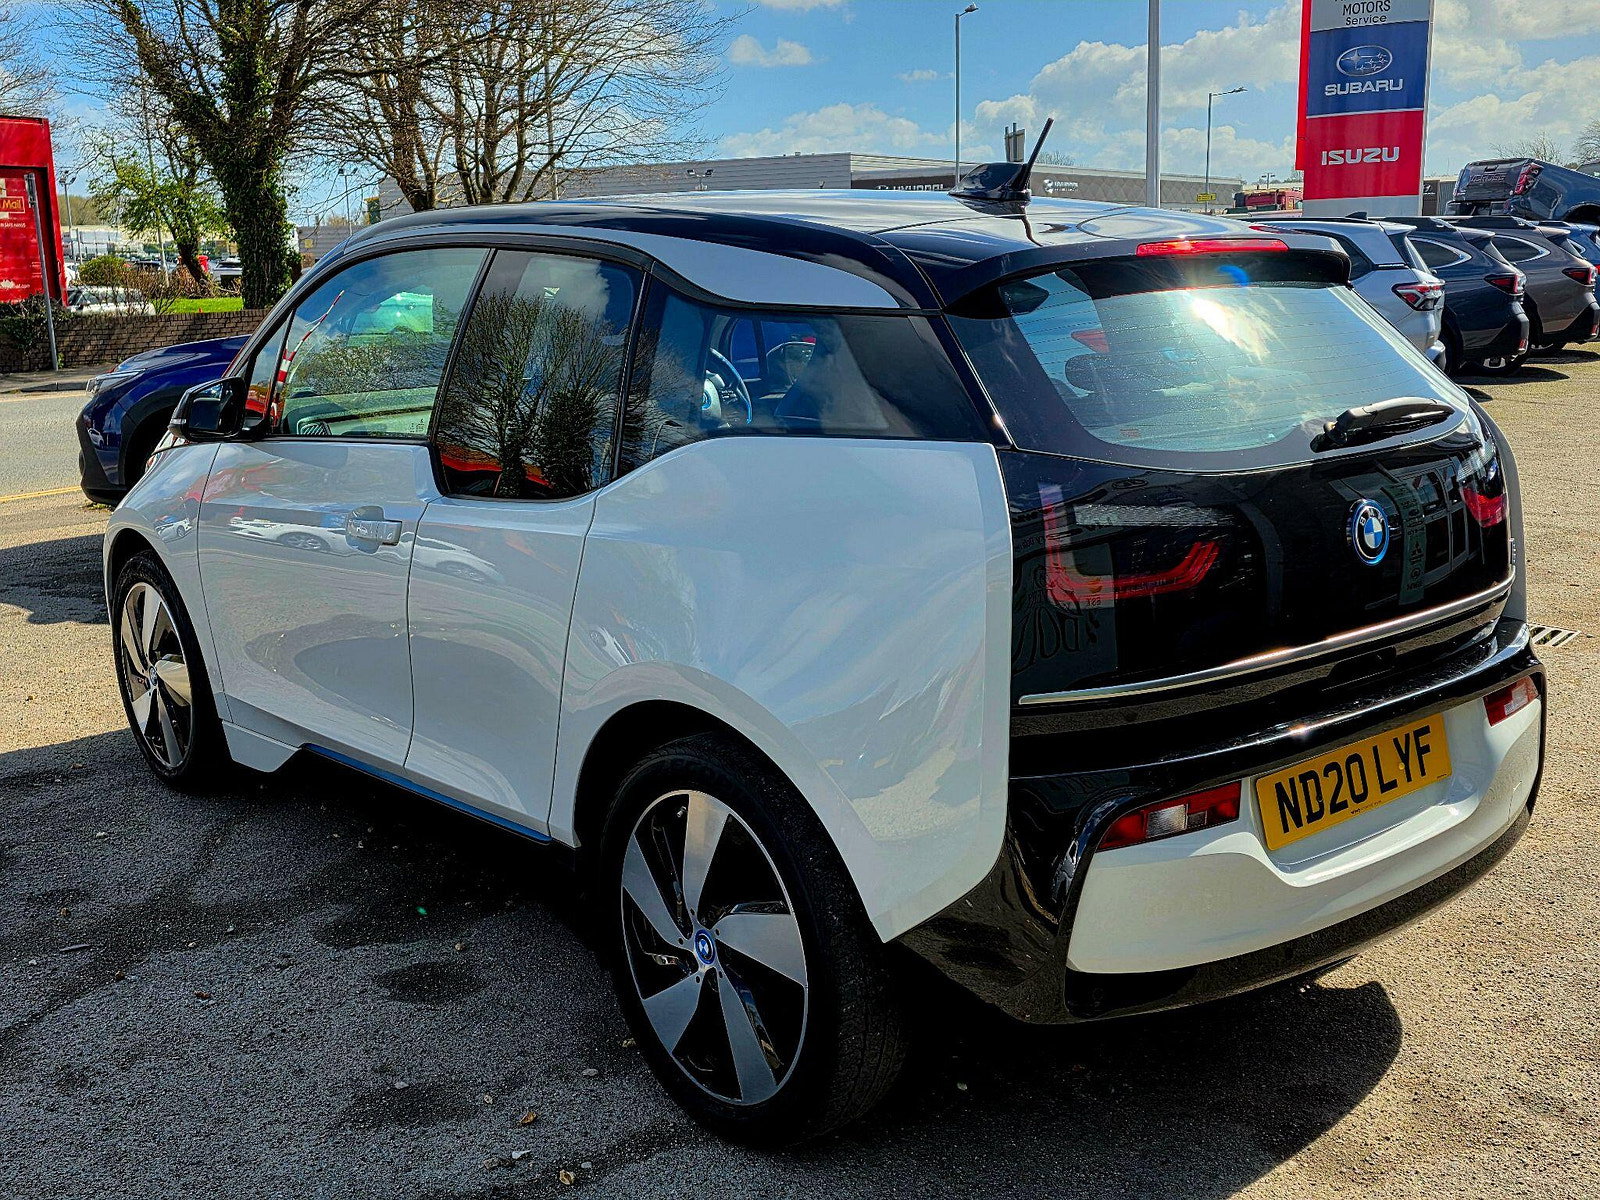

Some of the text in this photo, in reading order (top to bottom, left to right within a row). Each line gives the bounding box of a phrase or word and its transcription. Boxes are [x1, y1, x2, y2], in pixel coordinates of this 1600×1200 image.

[1342, 0, 1391, 15] MOTORS
[1345, 15, 1388, 25] Service
[1324, 78, 1403, 96] SUBARU
[1321, 146, 1400, 166] ISUZU
[2, 199, 22, 209] Mail
[1274, 724, 1431, 834] ND20 LYF
